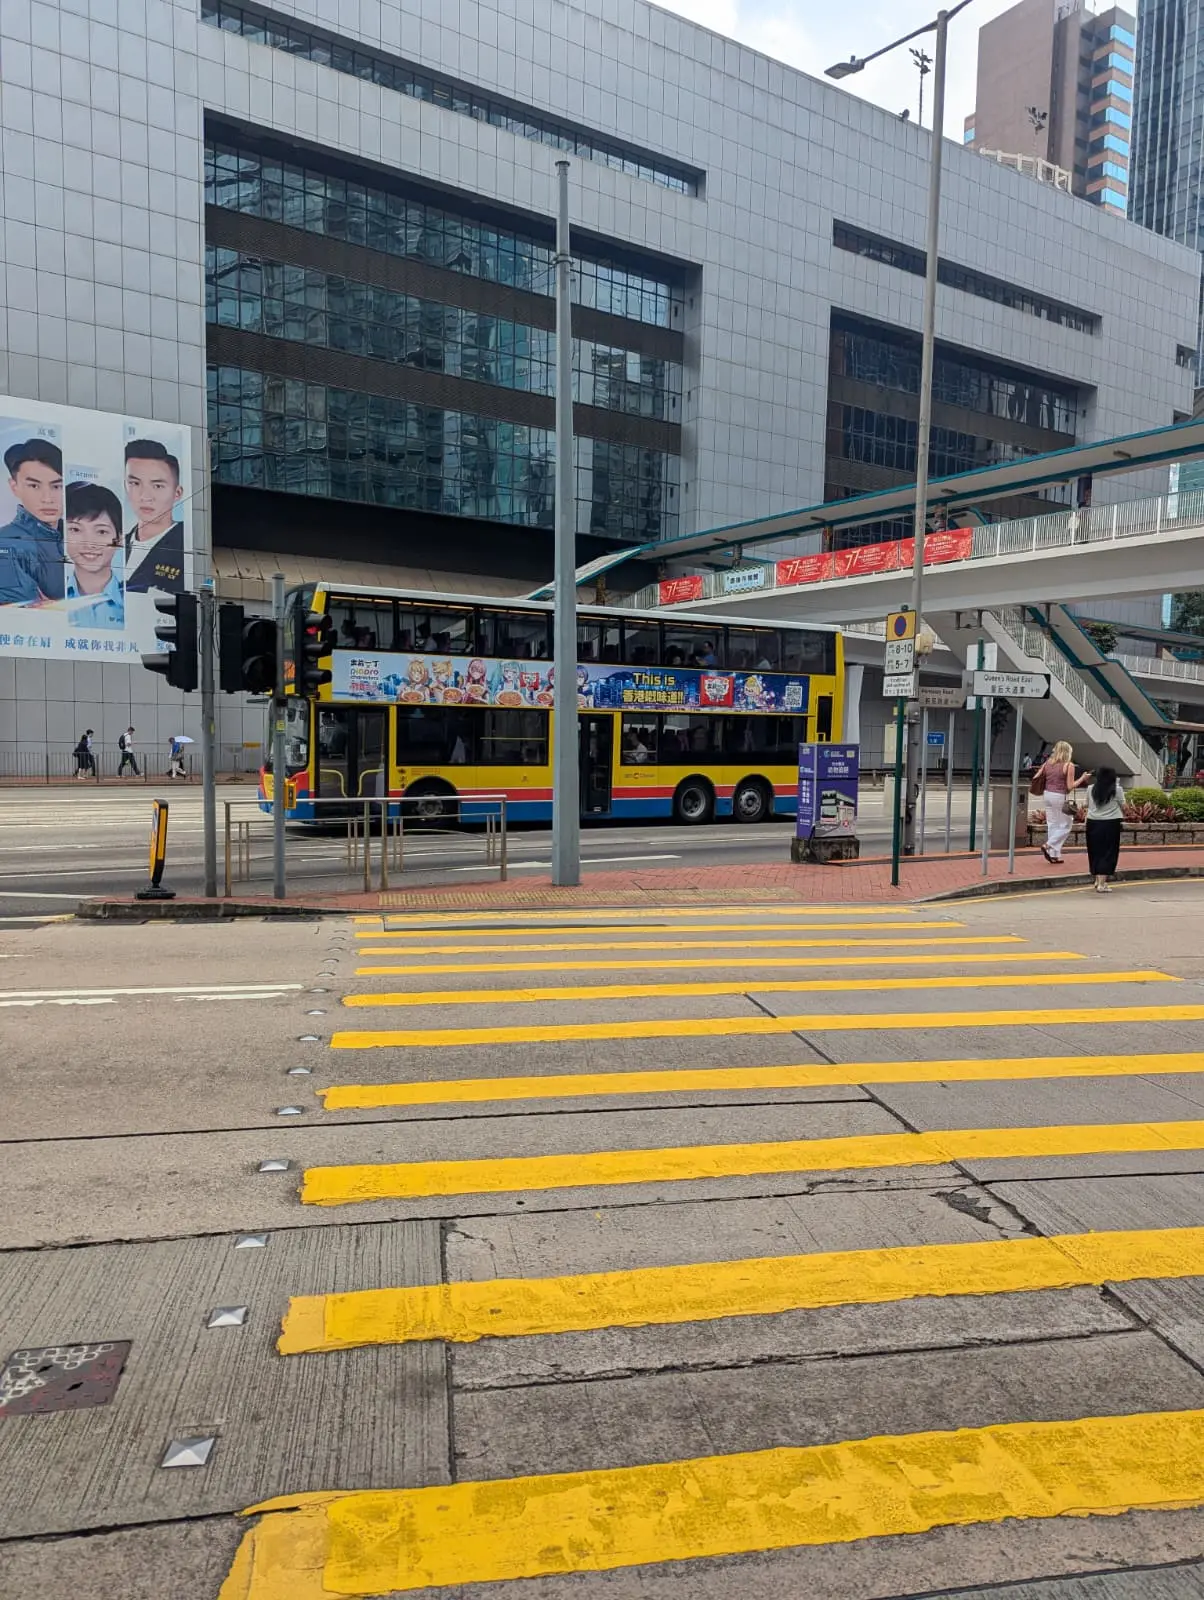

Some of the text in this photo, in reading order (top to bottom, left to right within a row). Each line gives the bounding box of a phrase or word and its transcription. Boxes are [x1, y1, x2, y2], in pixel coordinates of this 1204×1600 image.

[845, 549, 862, 571] 77
[786, 560, 800, 580] 77
[667, 582, 678, 599] 77
[896, 643, 913, 654] 8-10
[896, 659, 909, 669] 5-7
[633, 672, 675, 686] This is
[984, 674, 1004, 682] Queen's
[1006, 675, 1020, 683] Road
